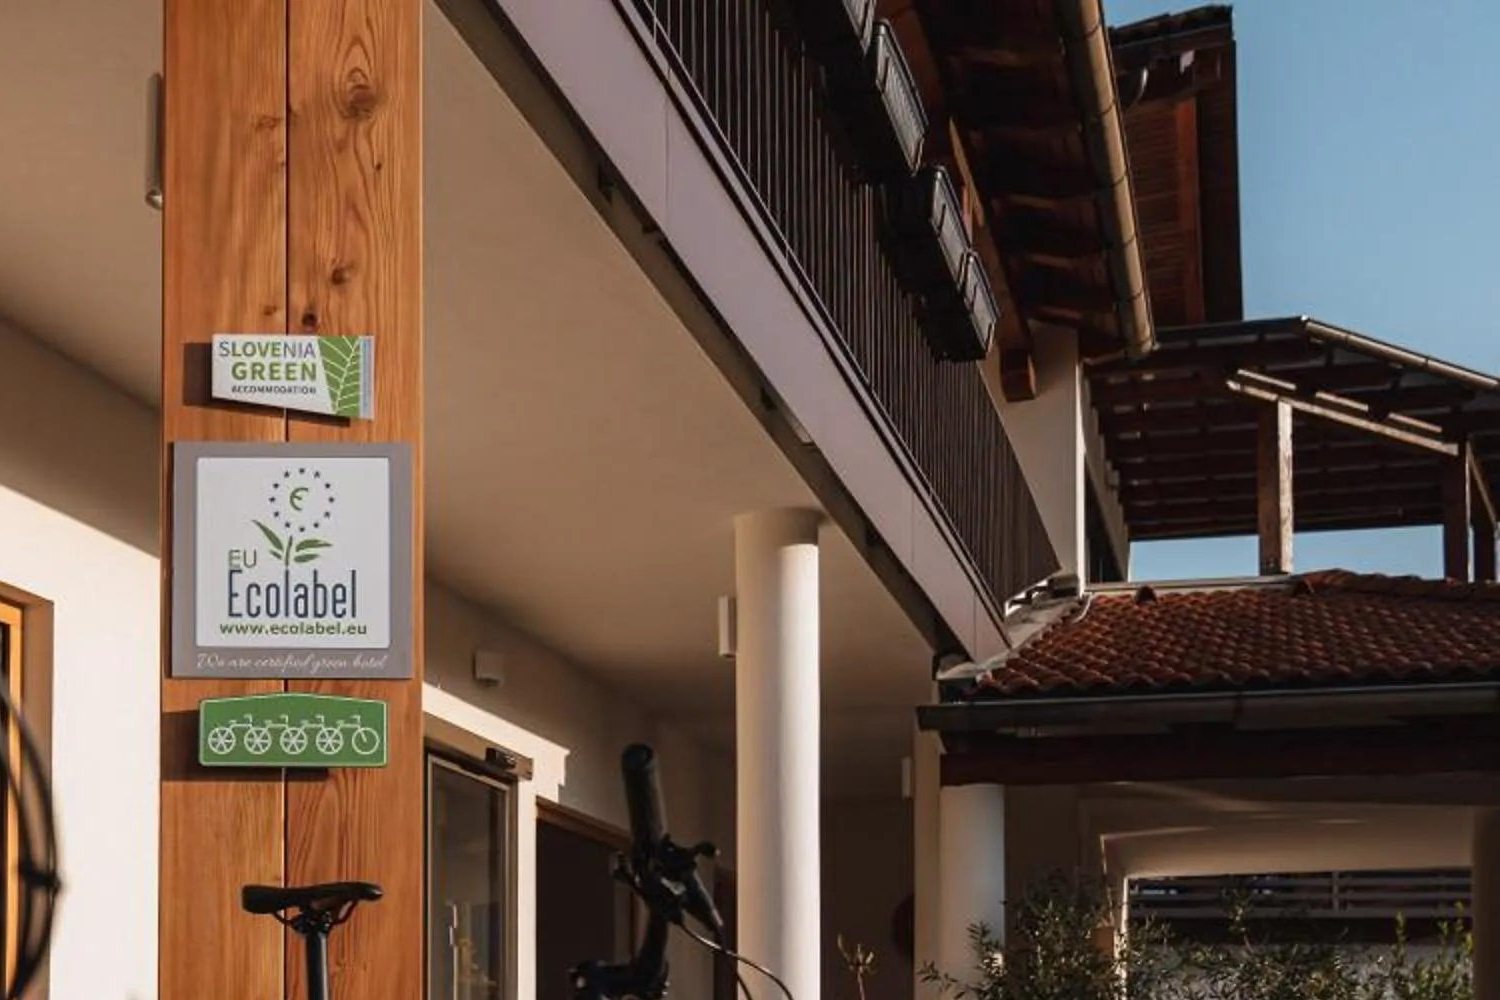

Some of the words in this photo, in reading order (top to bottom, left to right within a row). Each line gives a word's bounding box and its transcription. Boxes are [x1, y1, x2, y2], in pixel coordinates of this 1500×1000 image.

[219, 341, 317, 358] SLOVENIA
[231, 362, 317, 381] GREEN
[231, 385, 317, 395] ACCOMMODATION
[228, 549, 257, 569] EU
[228, 568, 357, 618] Ecolabel
[220, 622, 367, 635] www.ecolabel.eu
